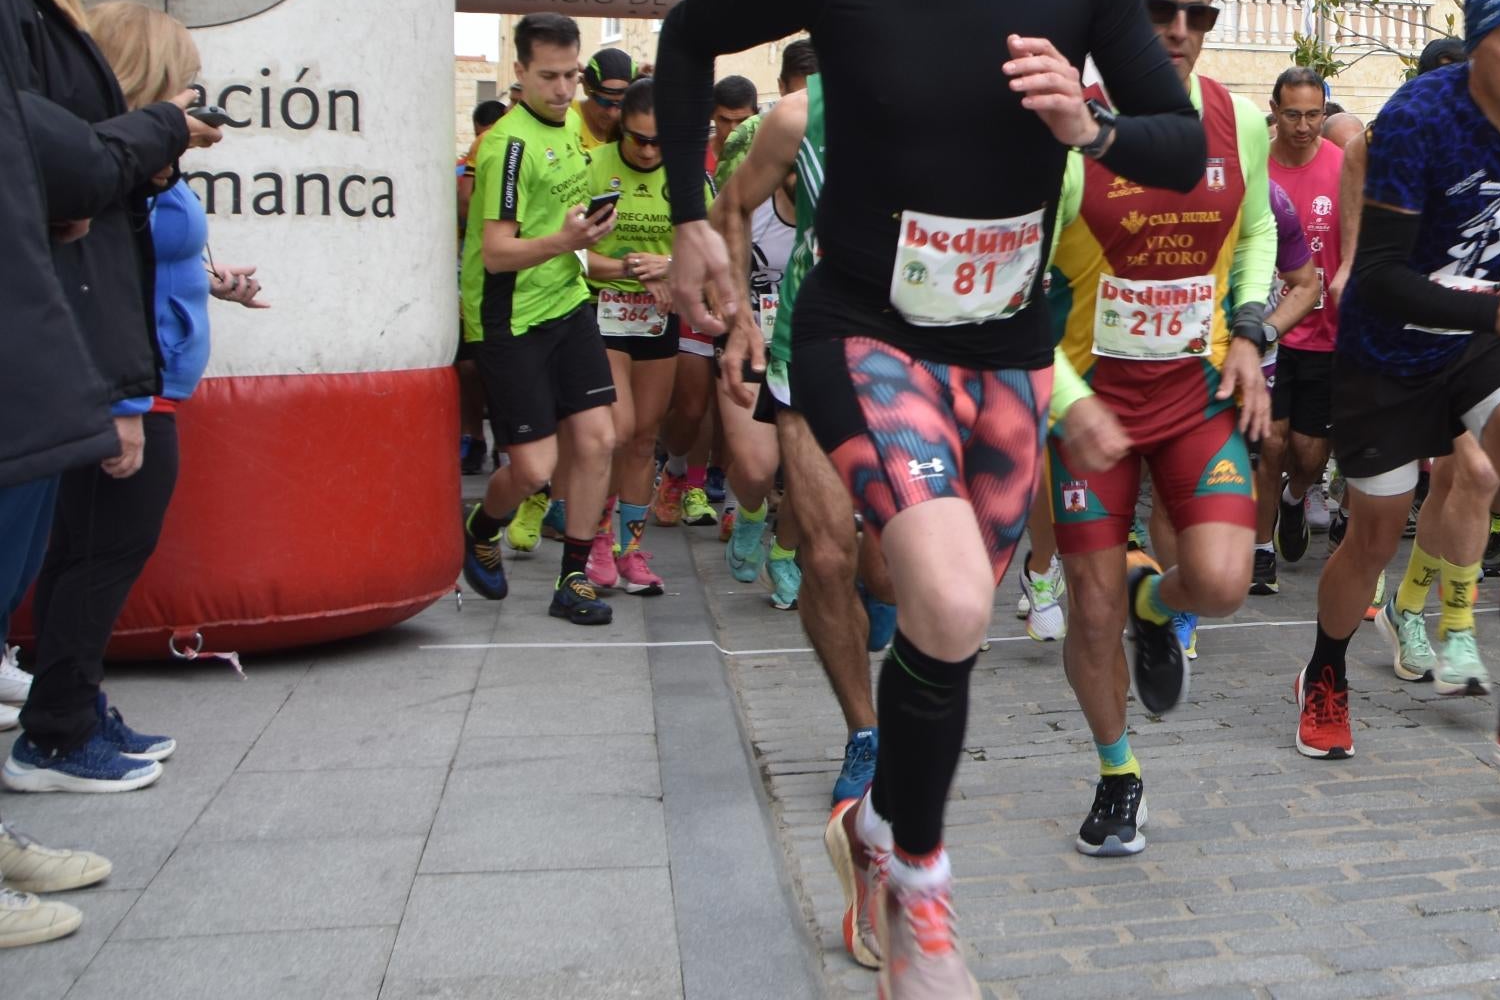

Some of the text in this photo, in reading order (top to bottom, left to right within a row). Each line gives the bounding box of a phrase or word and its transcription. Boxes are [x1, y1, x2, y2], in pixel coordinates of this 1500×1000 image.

[505, 141, 521, 209] CORRECAMINOS
[1148, 210, 1222, 226] CAJA RURAL
[906, 219, 1041, 255] bedunia
[1146, 233, 1195, 250] VINO
[1155, 250, 1208, 266] TORO
[952, 260, 998, 296] 81
[1101, 280, 1213, 307] bedunia
[617, 307, 650, 323] 364
[1129, 310, 1183, 337] 216
